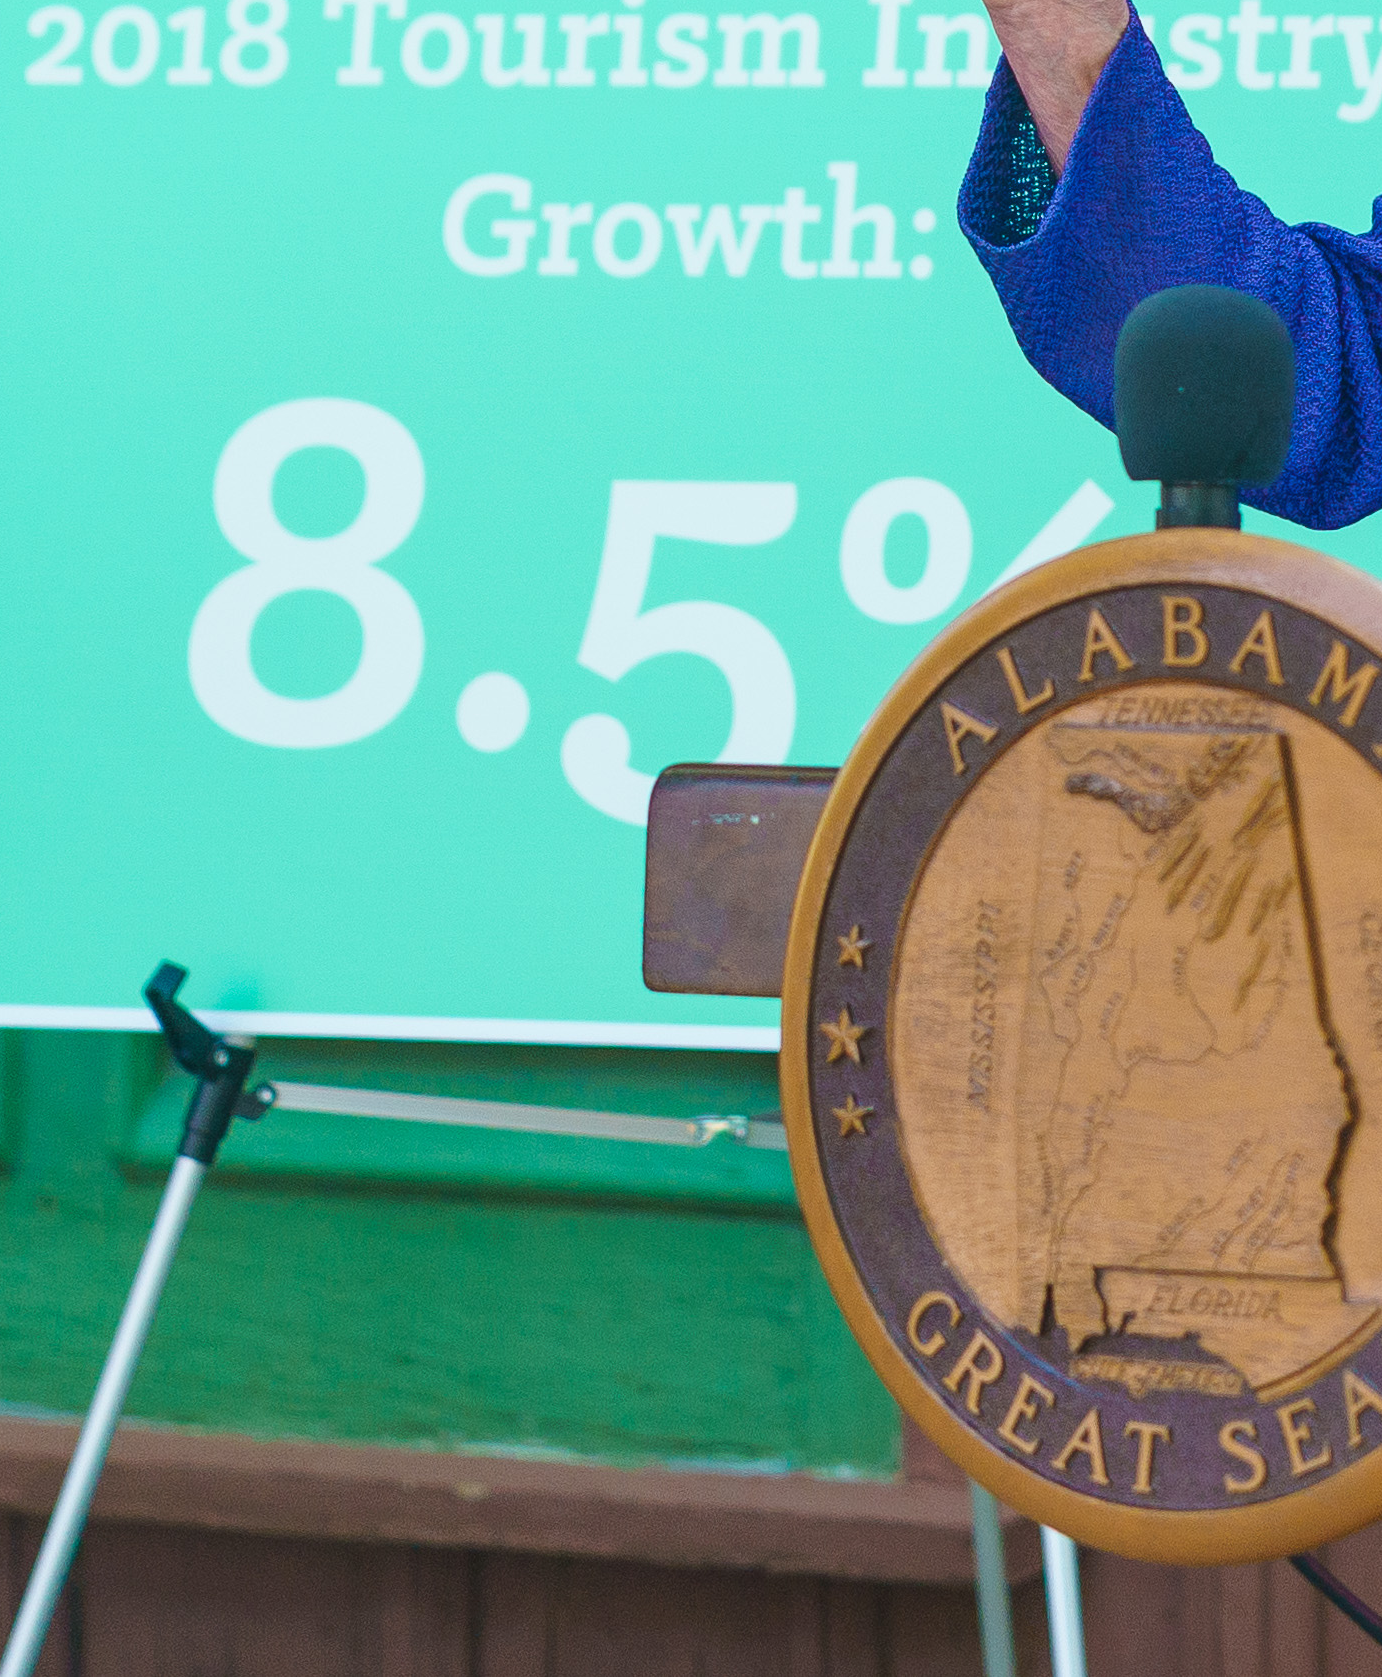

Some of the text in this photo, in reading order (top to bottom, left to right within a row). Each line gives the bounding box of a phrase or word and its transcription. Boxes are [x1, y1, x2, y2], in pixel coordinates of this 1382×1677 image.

[441, 159, 938, 282] Growth:
[1145, 1282, 1285, 1322] FLORIDA
[903, 1290, 1173, 1496] GREAT
